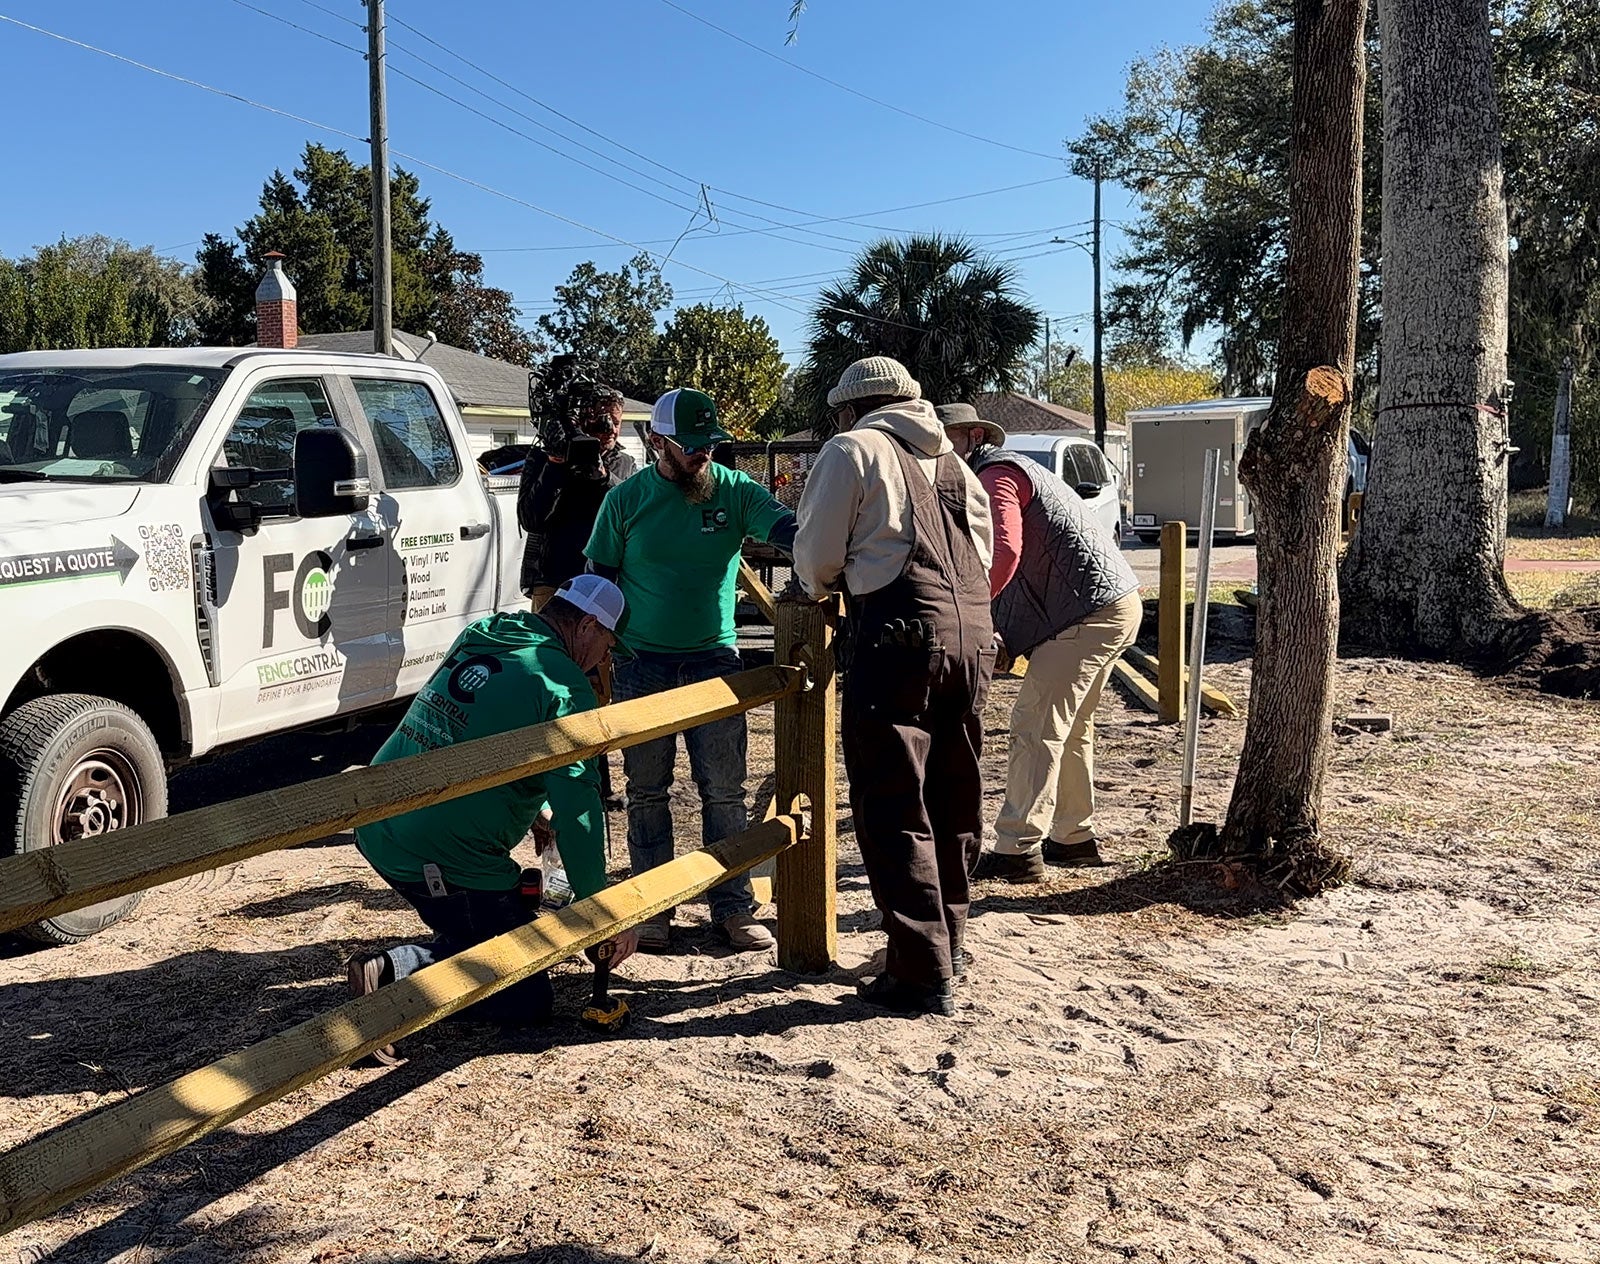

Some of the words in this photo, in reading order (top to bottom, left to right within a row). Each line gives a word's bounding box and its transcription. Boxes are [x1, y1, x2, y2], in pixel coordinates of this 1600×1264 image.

[400, 537, 418, 548] FREE
[419, 533, 454, 546] ESTIMATES
[0, 556, 50, 579] QUEST
[54, 557, 66, 573] A
[67, 551, 115, 571] QUOTE
[410, 553, 429, 569] Vinyl
[434, 551, 449, 563] PVC
[410, 571, 431, 585] Wood
[262, 550, 334, 649] FC
[409, 588, 446, 602] Aluminum
[408, 605, 430, 619] Chain
[431, 602, 447, 615] Link
[256, 651, 343, 684] FENCECENTRAL
[257, 690, 282, 703] DEFINE
[283, 684, 301, 697] YOUR
[302, 675, 342, 693] BOUNDARIES
[58, 716, 106, 757] MICHELIN
